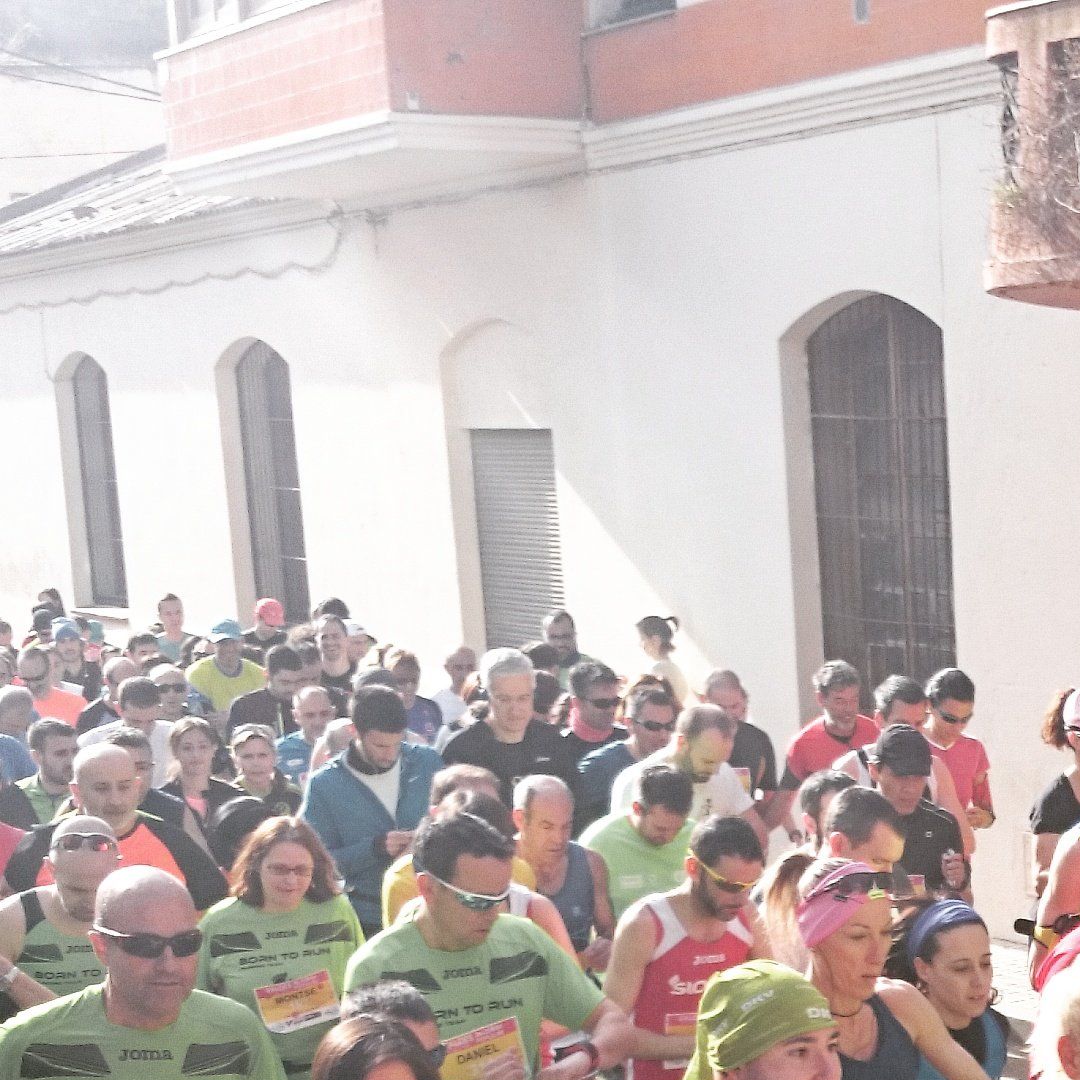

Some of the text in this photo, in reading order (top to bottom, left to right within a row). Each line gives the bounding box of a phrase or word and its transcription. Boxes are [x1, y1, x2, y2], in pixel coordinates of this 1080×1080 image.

[239, 947, 331, 966] BORN TO RUN
[34, 969, 102, 980] BORN TO
[463, 1004, 483, 1015] TO
[488, 998, 524, 1010] RUN
[457, 1044, 500, 1065] DANIEL
